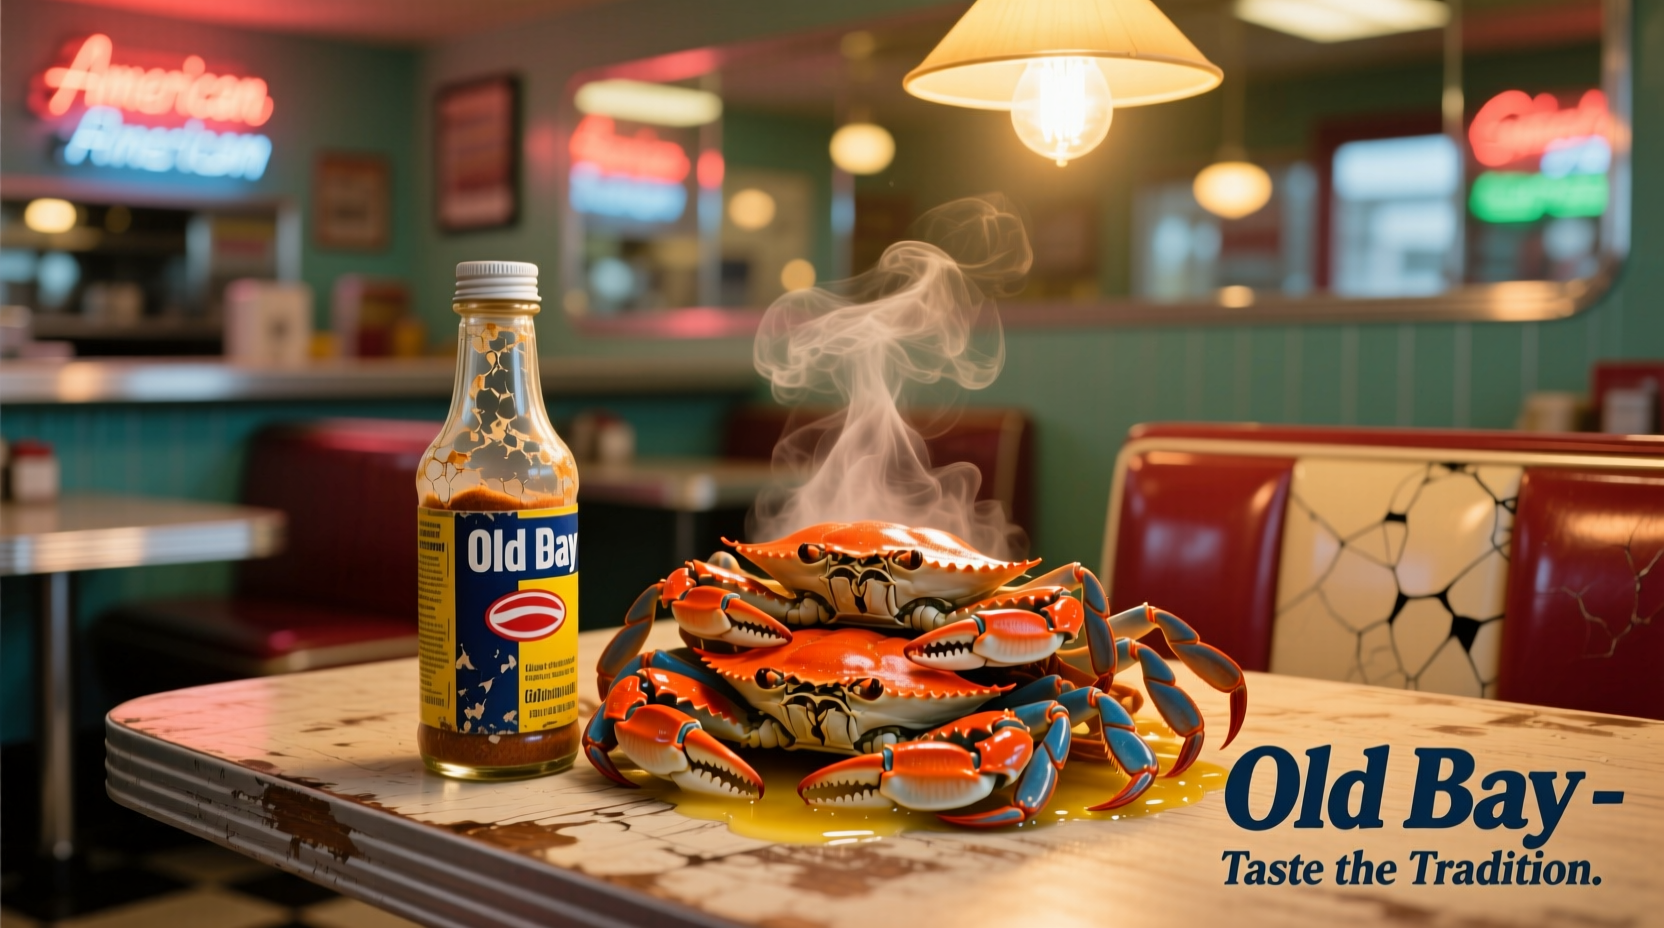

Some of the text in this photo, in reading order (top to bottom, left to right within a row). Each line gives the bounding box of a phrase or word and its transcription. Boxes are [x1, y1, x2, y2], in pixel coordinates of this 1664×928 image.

[44, 33, 274, 127] American
[467, 528, 526, 573] Old
[535, 527, 578, 573] Bay
